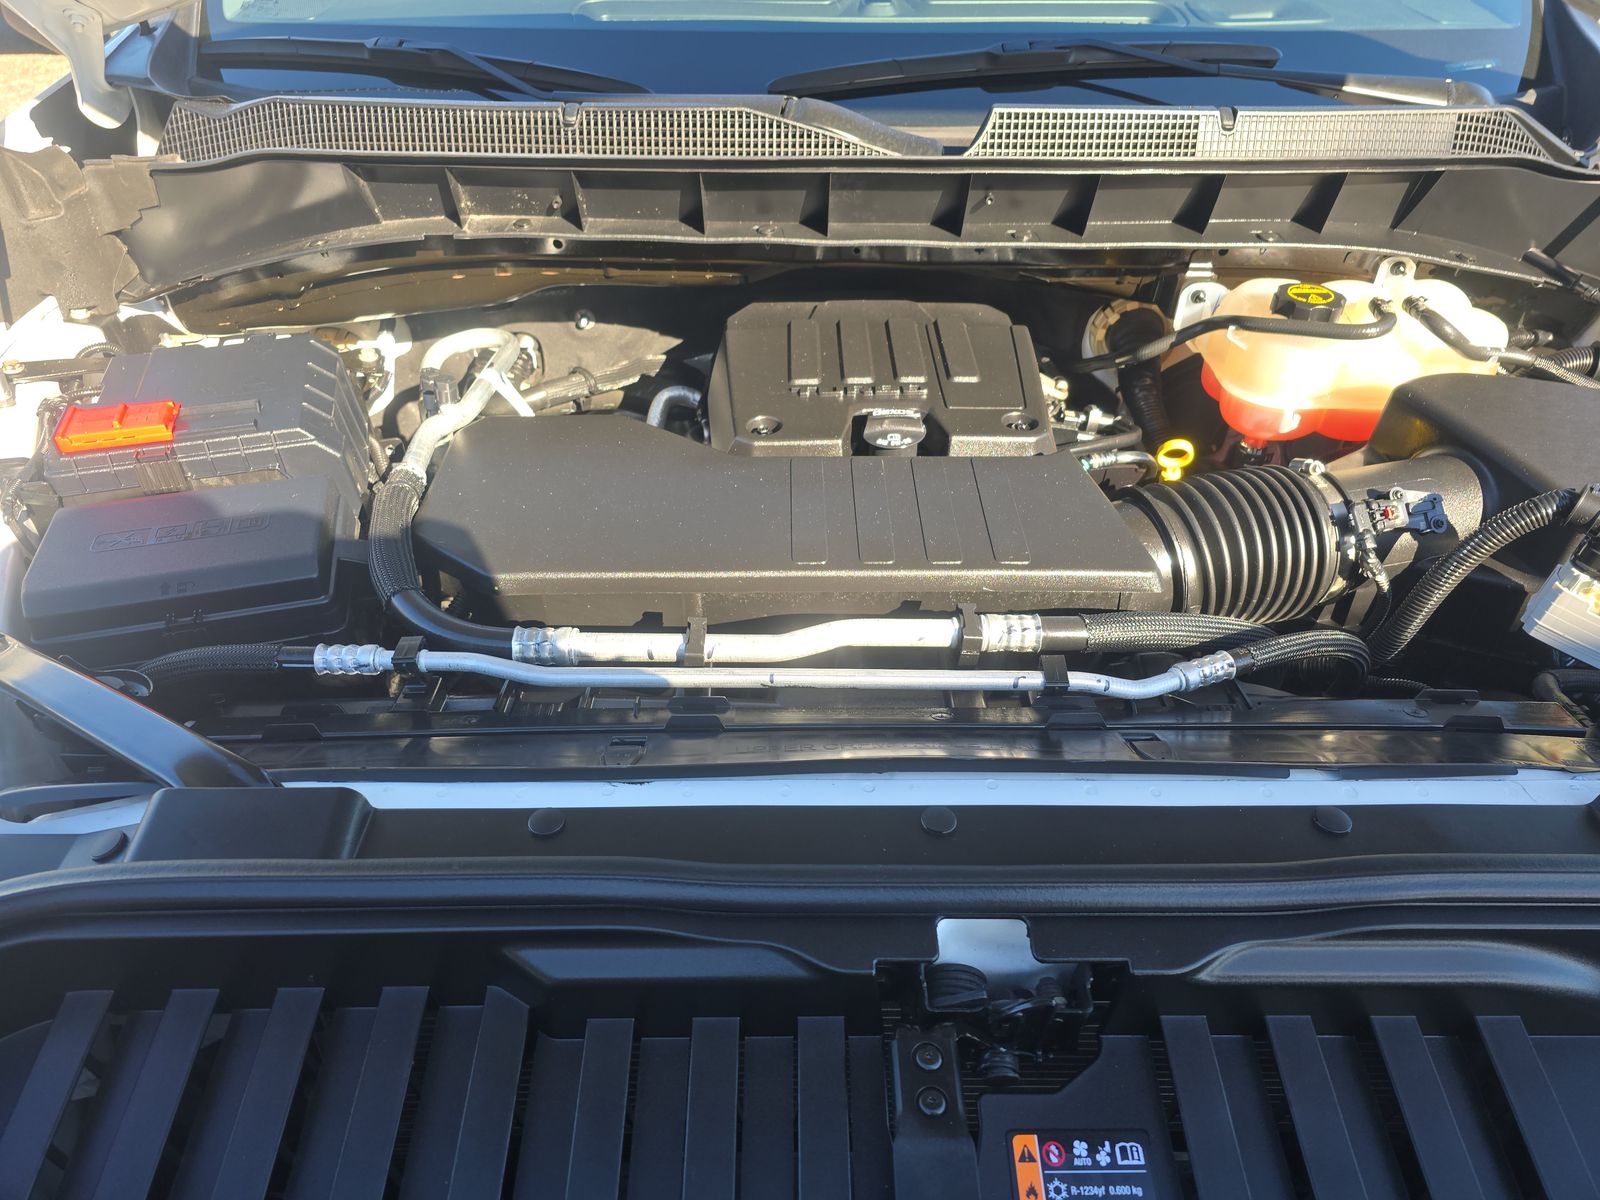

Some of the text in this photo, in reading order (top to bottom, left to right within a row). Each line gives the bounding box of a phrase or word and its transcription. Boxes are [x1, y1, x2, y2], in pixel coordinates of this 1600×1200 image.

[1074, 1157, 1092, 1166] AUTO
[1070, 1185, 1105, 1197] R-1234yf
[1132, 1186, 1143, 1197] kg
